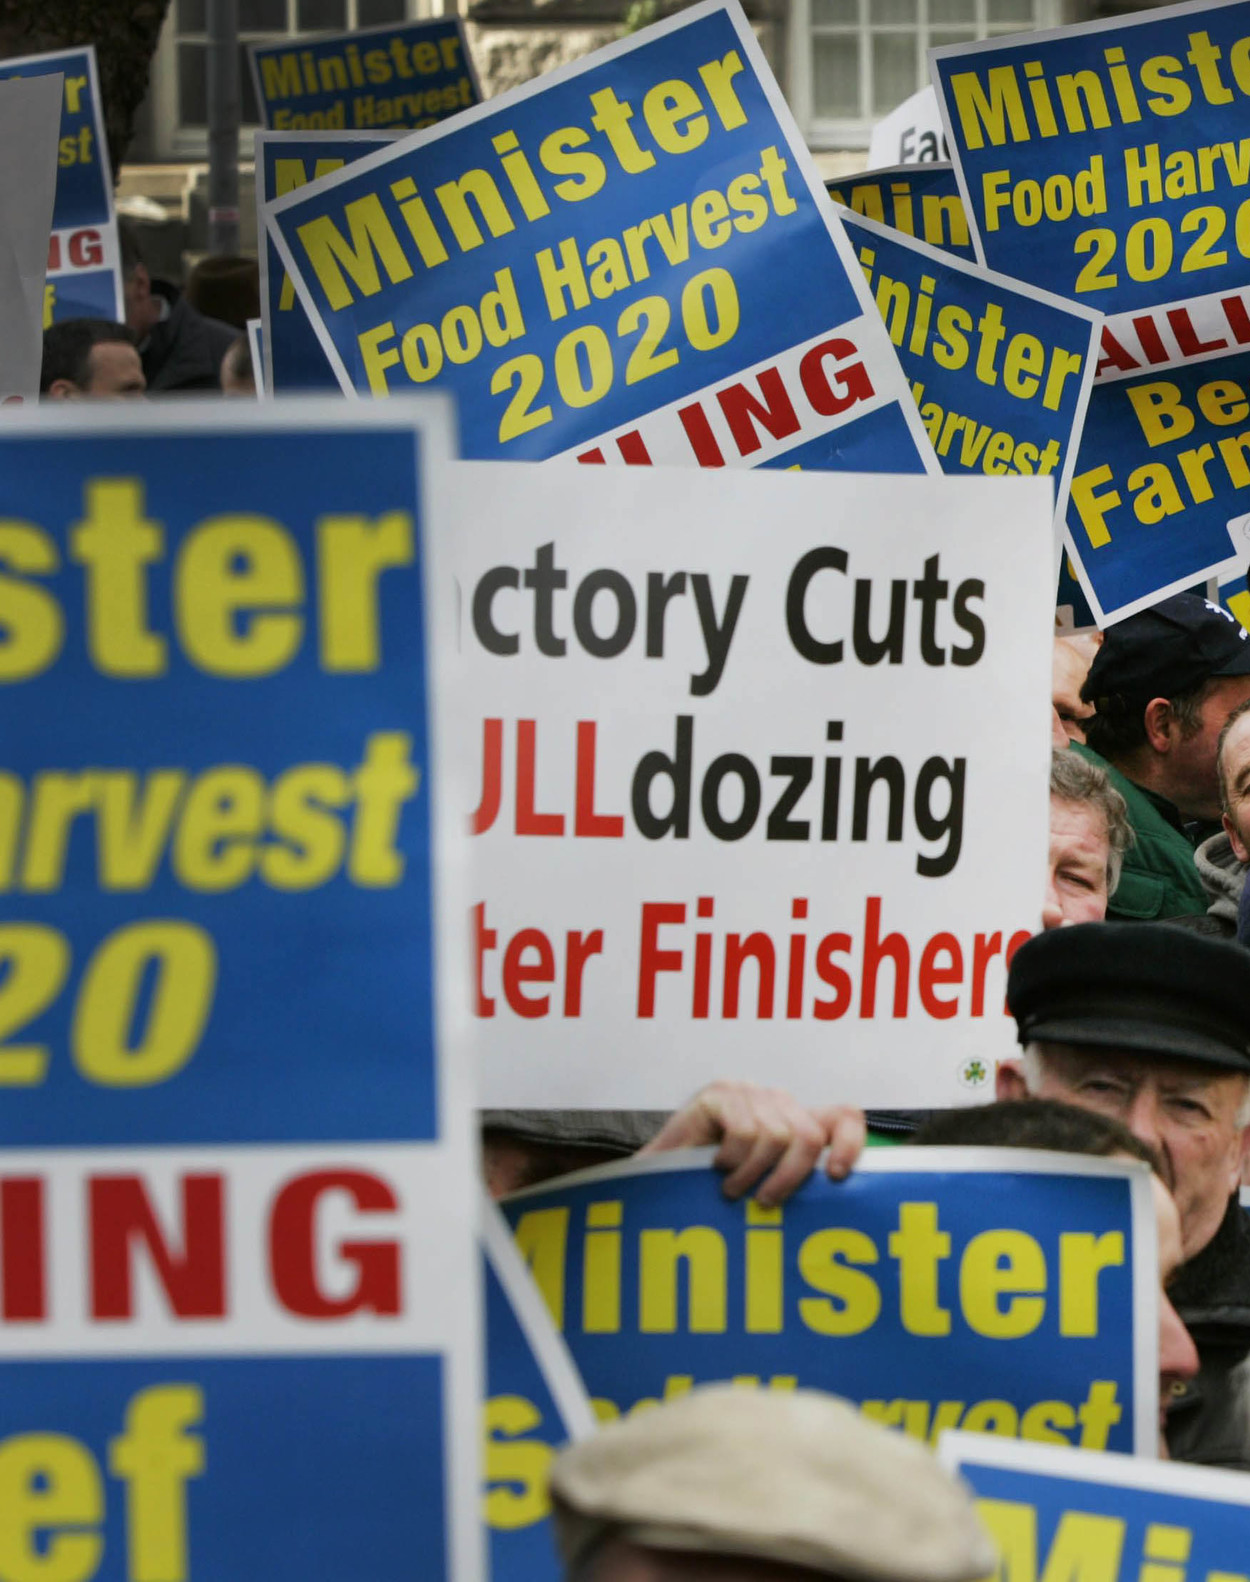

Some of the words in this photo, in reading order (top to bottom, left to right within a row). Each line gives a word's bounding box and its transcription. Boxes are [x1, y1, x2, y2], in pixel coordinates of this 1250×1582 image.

[260, 35, 460, 100] Minister
[354, 78, 471, 127] Harvest
[900, 125, 951, 164] Fa
[296, 49, 747, 312] Minister
[982, 155, 1106, 232] Food
[358, 267, 526, 398] Food
[534, 145, 797, 322] Harvest
[490, 267, 741, 443] 2020
[454, 542, 750, 697] ctory
[785, 545, 987, 667] Cuts
[0, 733, 419, 890] rvest
[0, 1166, 406, 1325] ING
